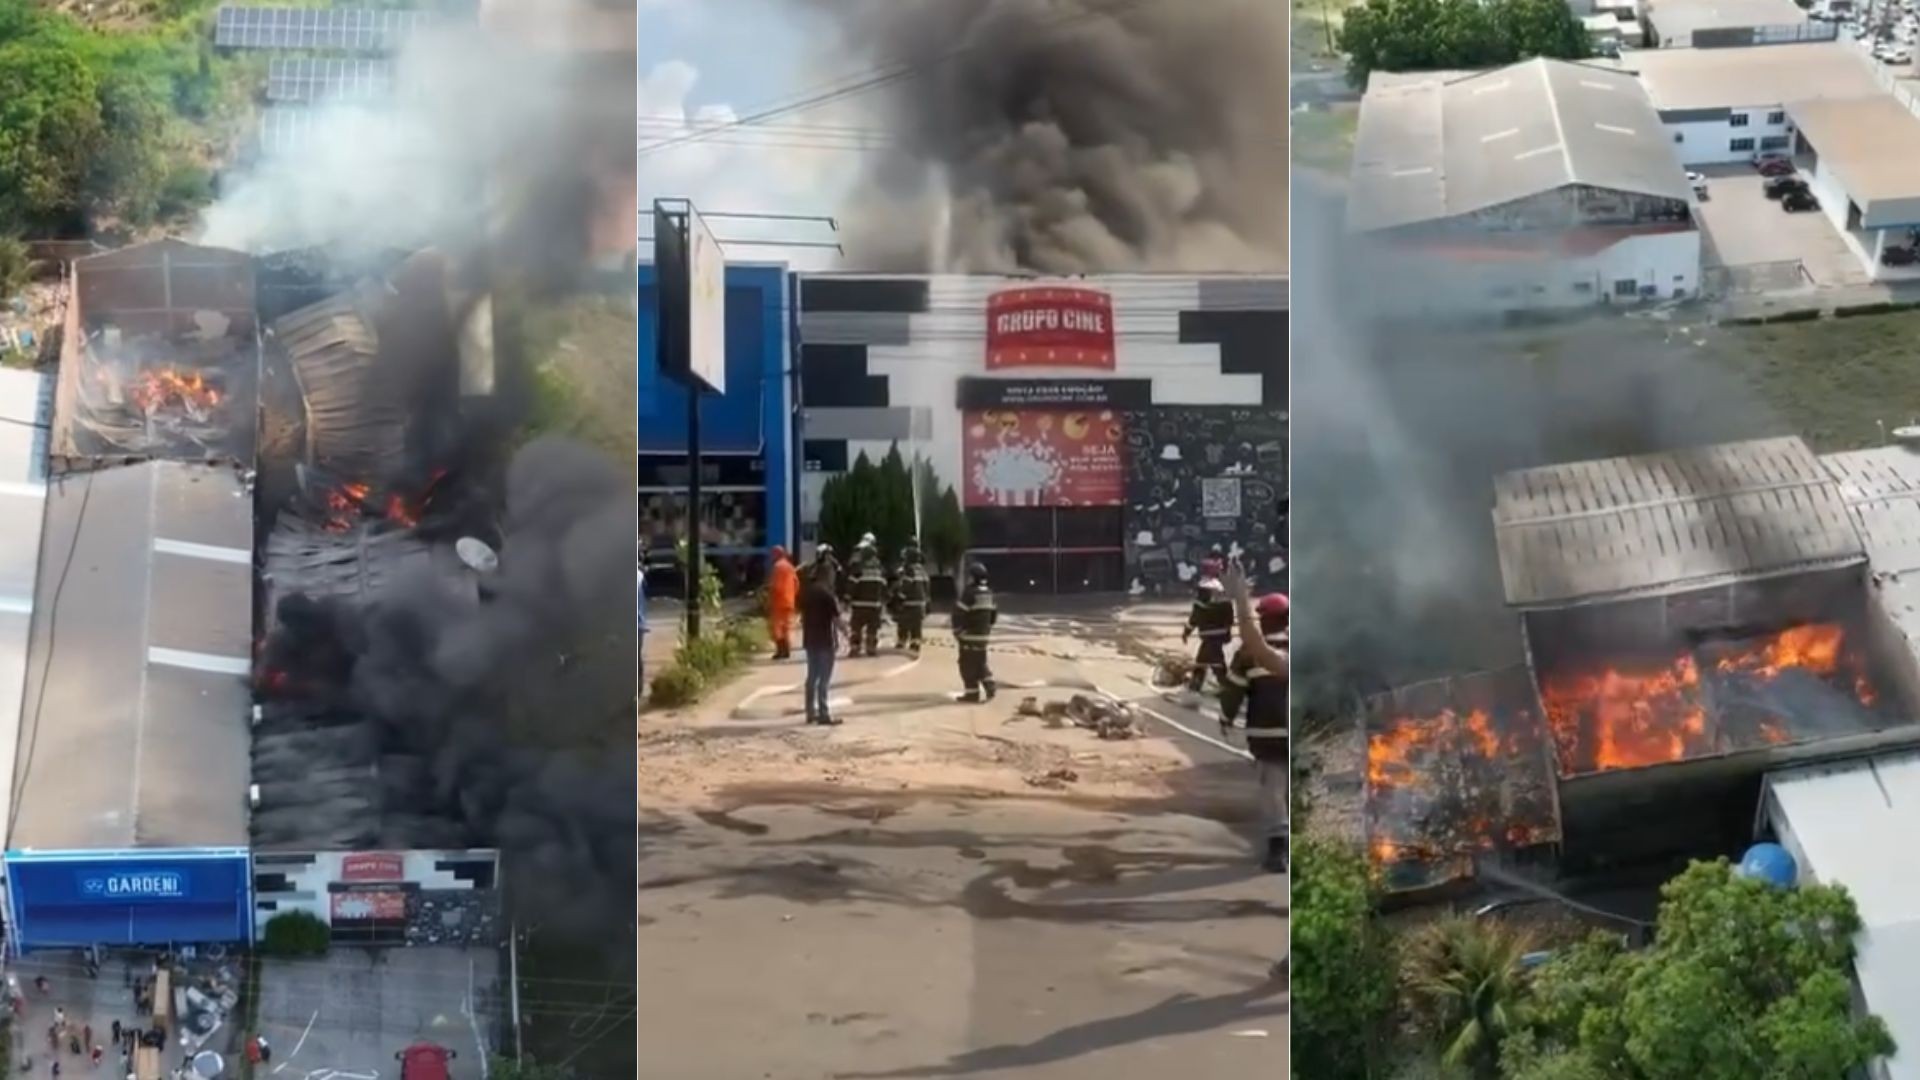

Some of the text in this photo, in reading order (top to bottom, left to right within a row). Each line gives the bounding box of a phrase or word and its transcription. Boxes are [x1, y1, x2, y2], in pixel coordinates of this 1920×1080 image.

[997, 308, 1106, 334] GRUPO CINE
[107, 877, 178, 893] GARDENI
